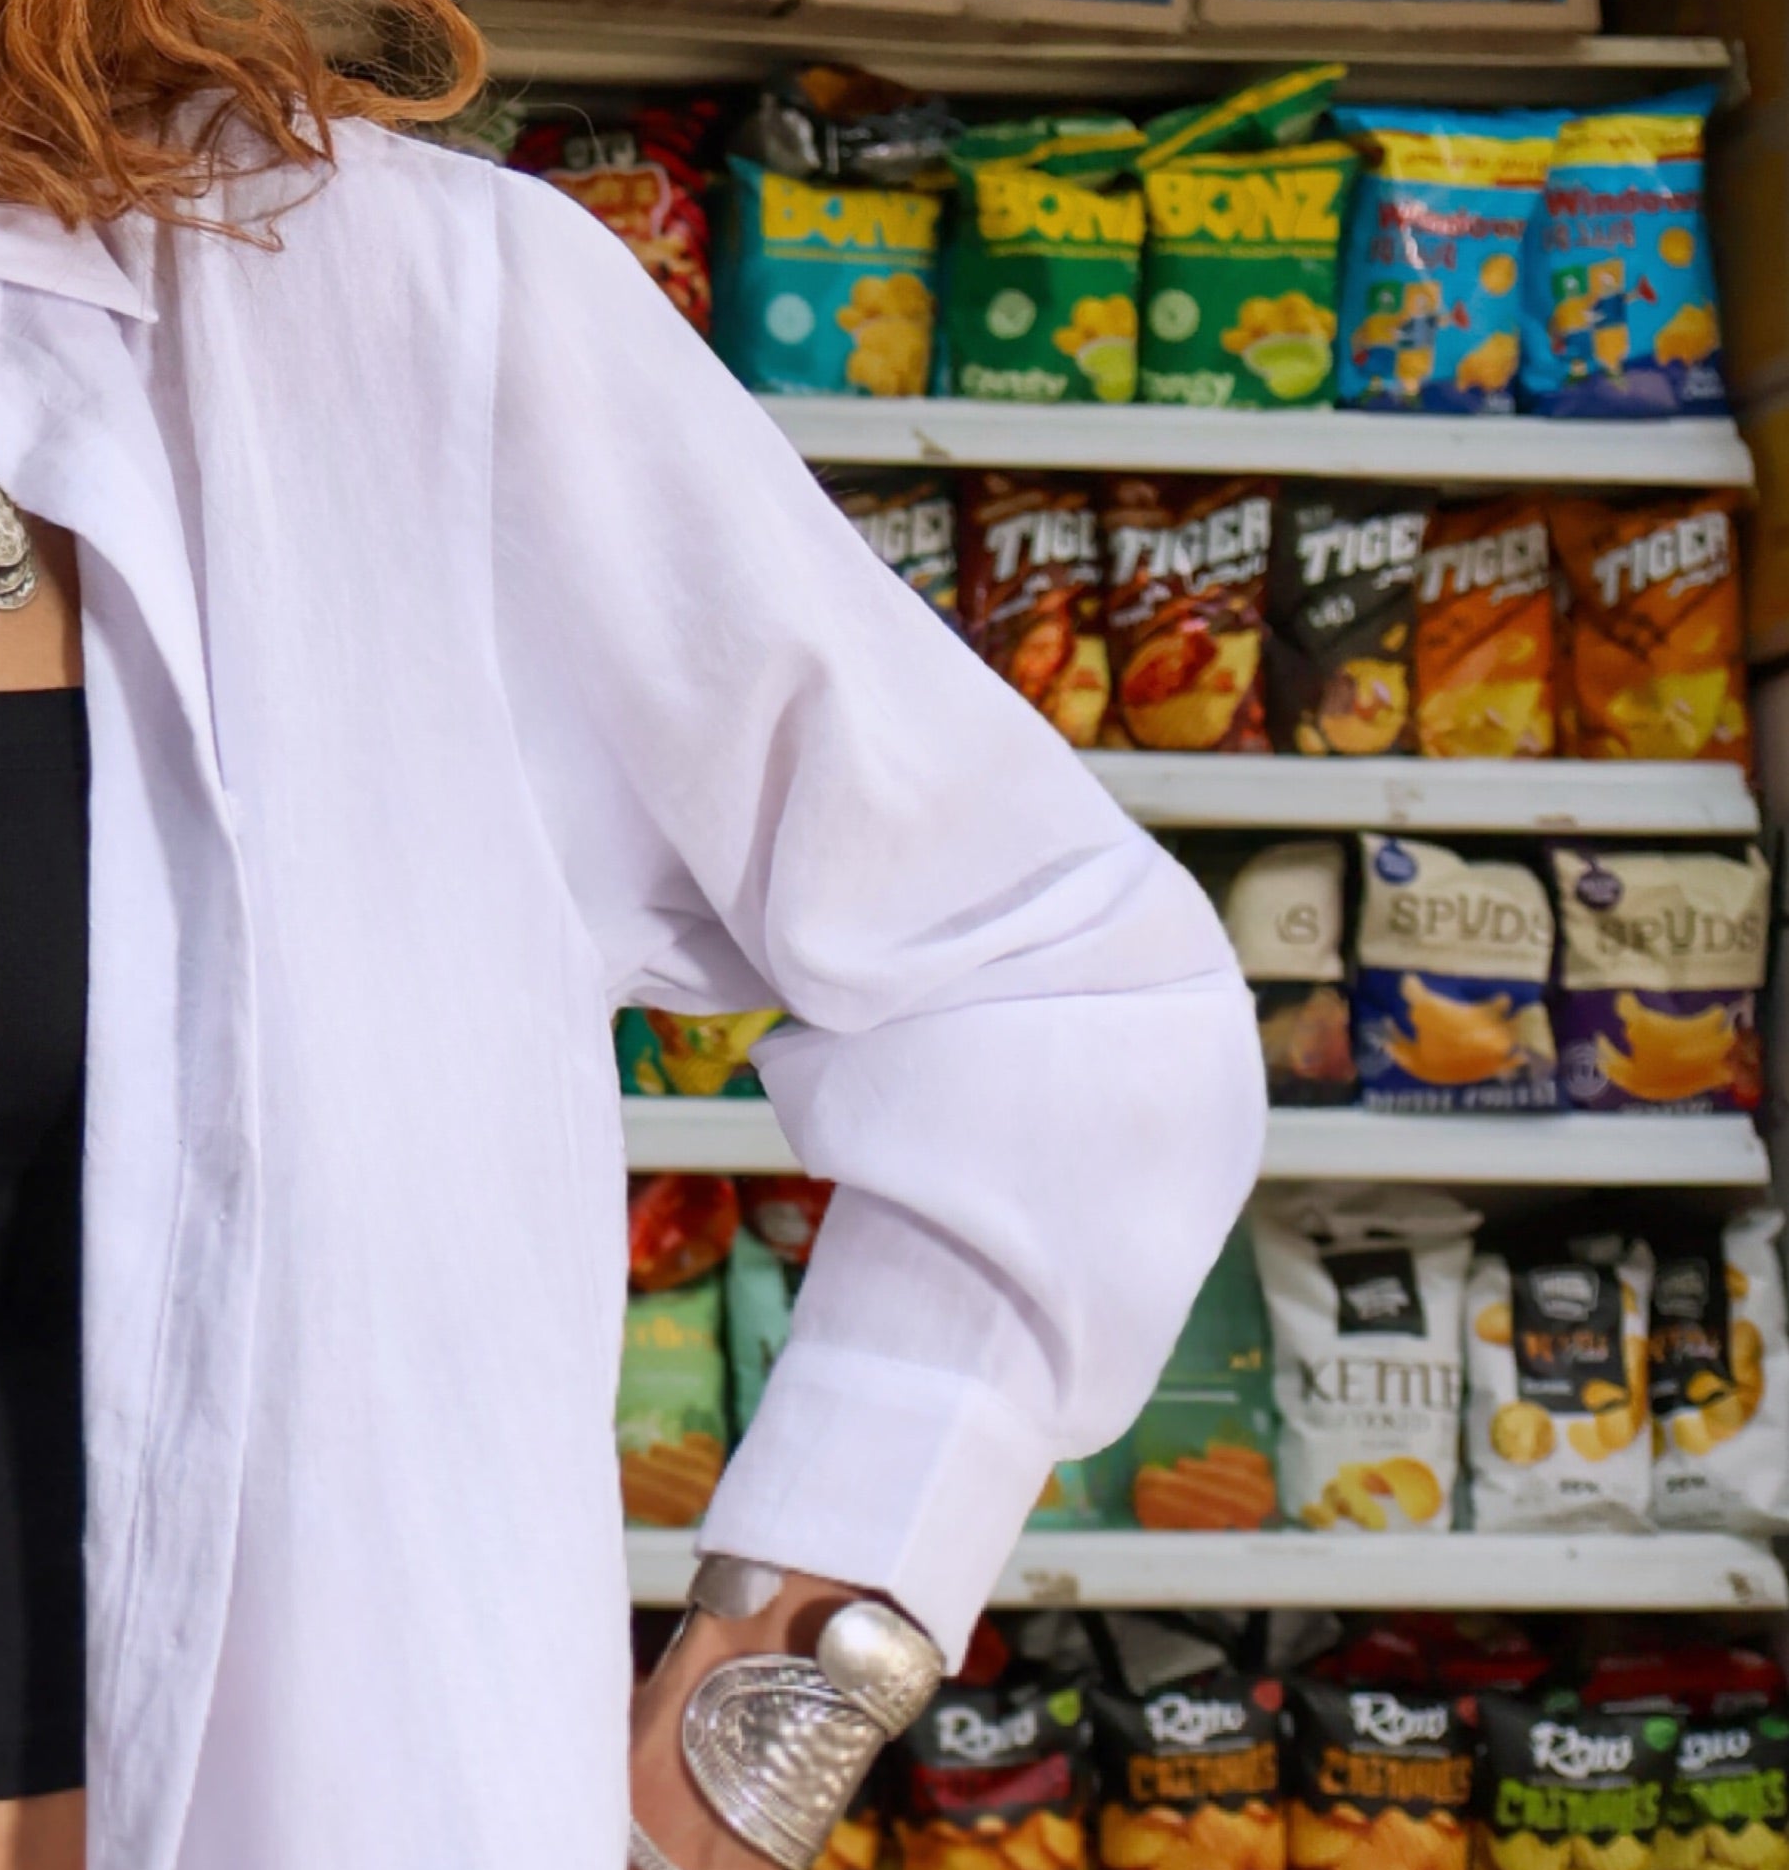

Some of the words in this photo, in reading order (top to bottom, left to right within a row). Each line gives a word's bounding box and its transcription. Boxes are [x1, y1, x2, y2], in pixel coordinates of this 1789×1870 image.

[1146, 171, 1342, 241] BONZ
[1114, 497, 1272, 584] TIGER
[1418, 522, 1549, 603] TIGER
[1593, 511, 1730, 605] TIGER
